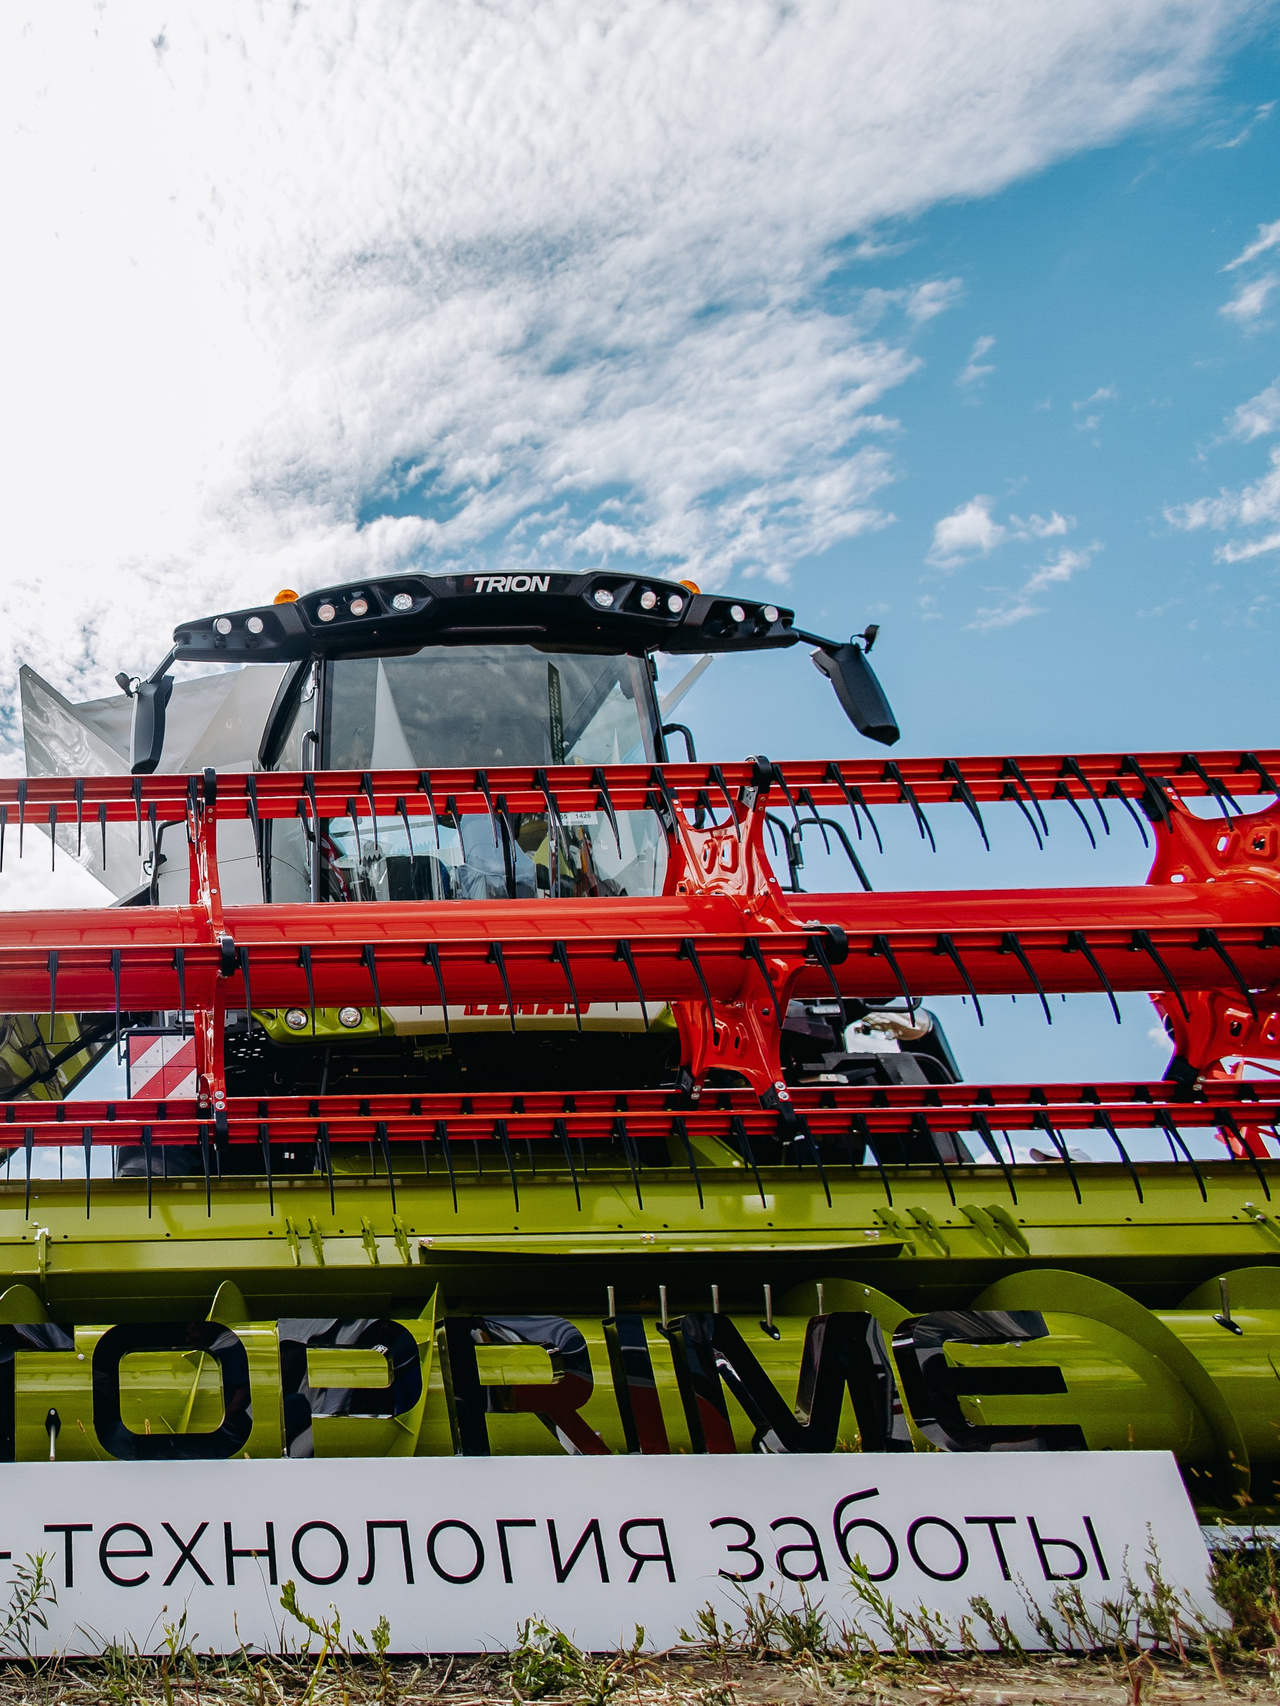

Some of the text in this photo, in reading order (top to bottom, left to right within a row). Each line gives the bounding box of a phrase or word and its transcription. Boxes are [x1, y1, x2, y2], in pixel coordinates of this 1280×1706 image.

[474, 575, 551, 593] TRION
[44, 1516, 677, 1588] технология
[708, 1487, 1110, 1583] заботы
